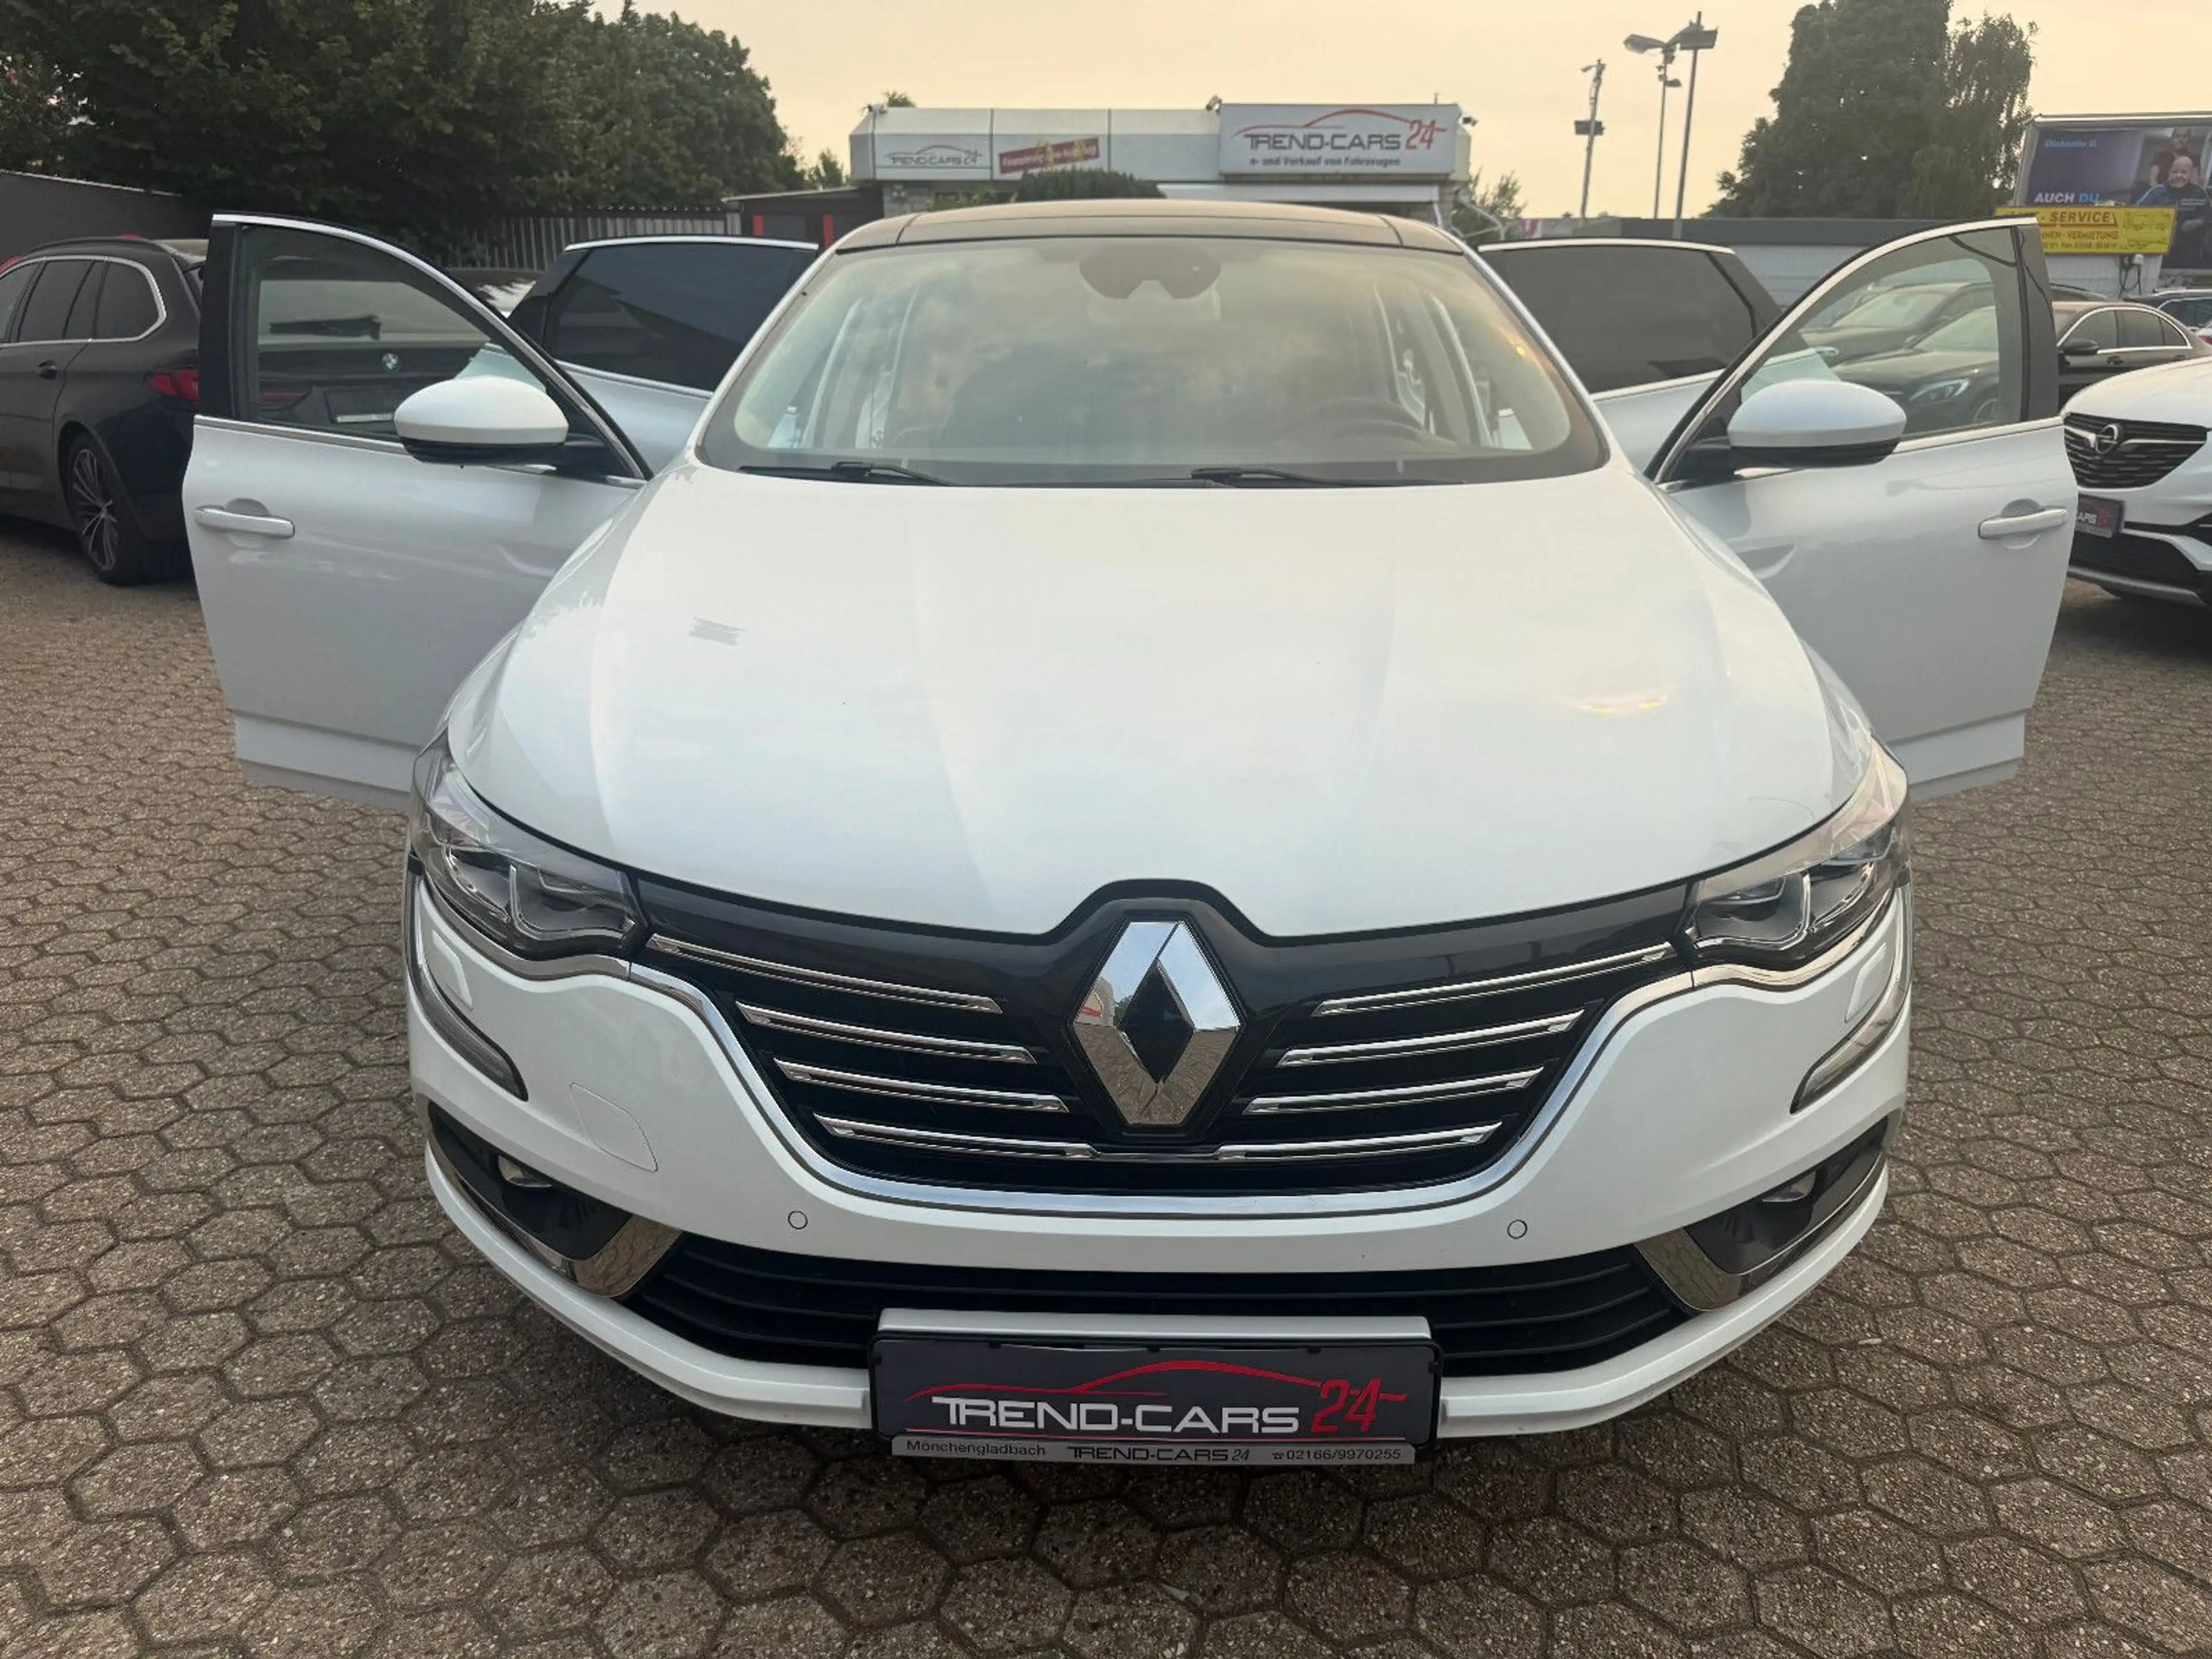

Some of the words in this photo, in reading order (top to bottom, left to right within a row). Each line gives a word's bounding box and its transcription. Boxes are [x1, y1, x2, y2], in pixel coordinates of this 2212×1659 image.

[1244, 134, 1402, 150] TREND-CARS
[1406, 119, 1436, 150] 24
[1283, 156, 1322, 165] Verkauf
[1344, 157, 1401, 168] Fahrzeugen
[2035, 192, 2075, 203] AUCH
[2050, 211, 2109, 223] SERVICE
[931, 1396, 1300, 1433] TREND-CARS
[1310, 1377, 1381, 1433] 24
[1067, 1446, 1229, 1461] TREND-CARS
[1232, 1449, 1250, 1461] 24
